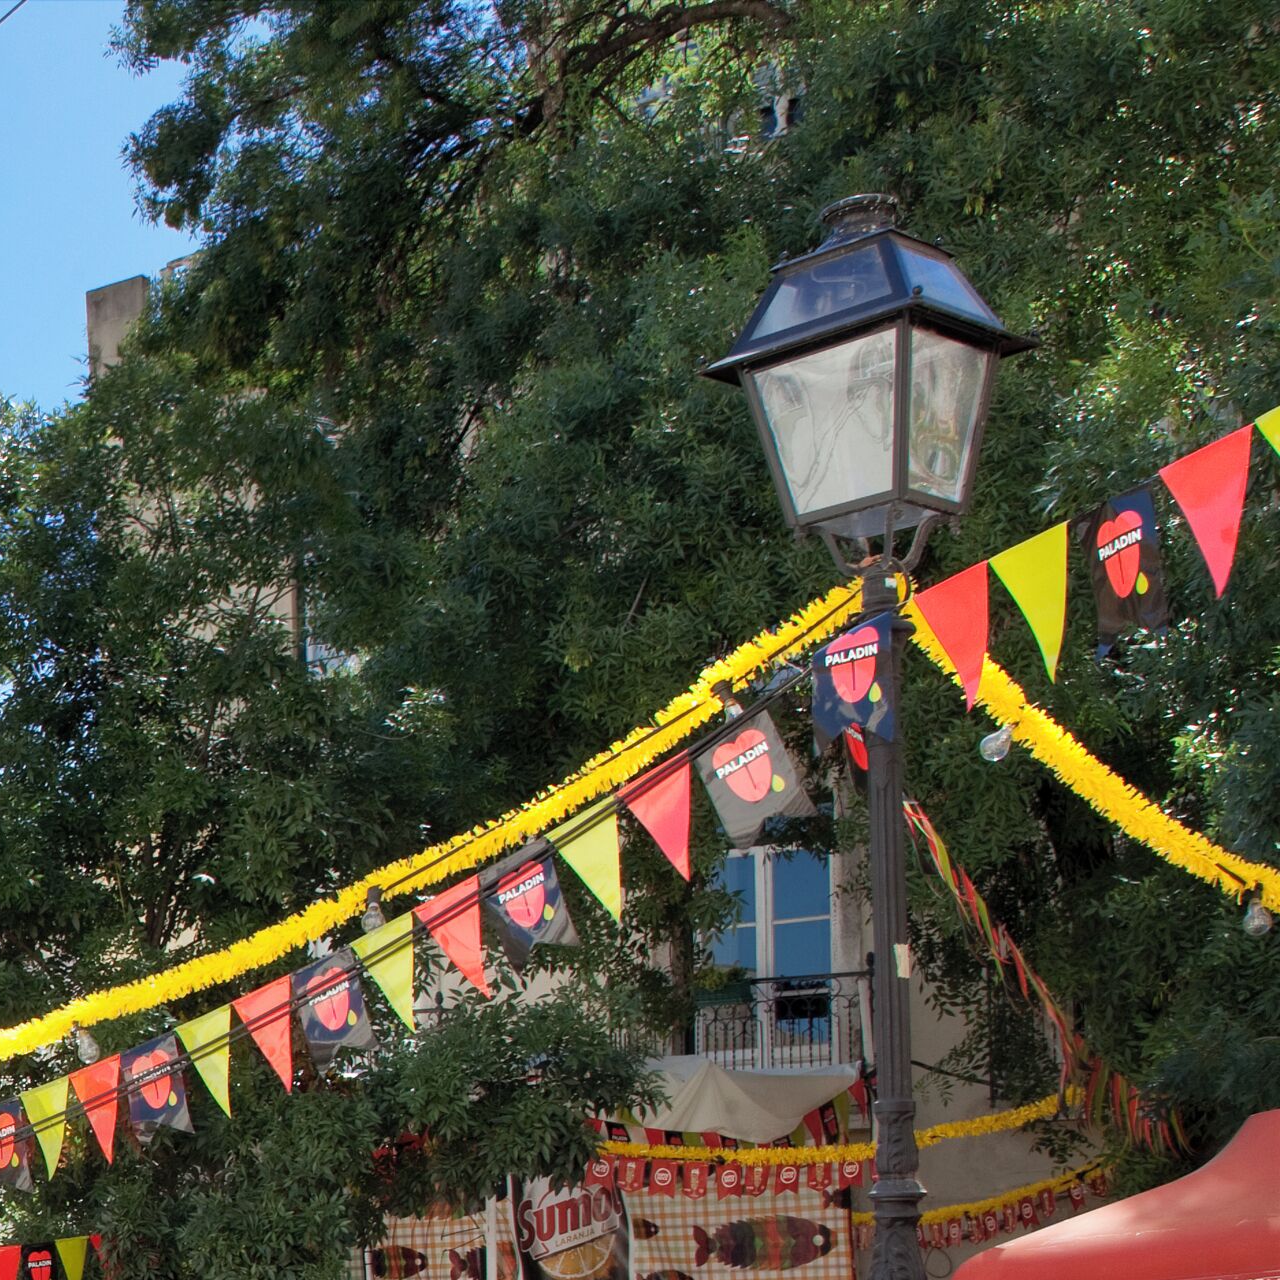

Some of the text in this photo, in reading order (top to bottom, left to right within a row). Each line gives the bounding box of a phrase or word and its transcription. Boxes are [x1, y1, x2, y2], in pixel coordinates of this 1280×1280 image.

[1097, 528, 1143, 561] PALADIN
[824, 643, 878, 667] PALADIN
[715, 741, 770, 779] PALADIN
[498, 872, 545, 904] PALADIN
[28, 1260, 52, 1269] PALADIN
